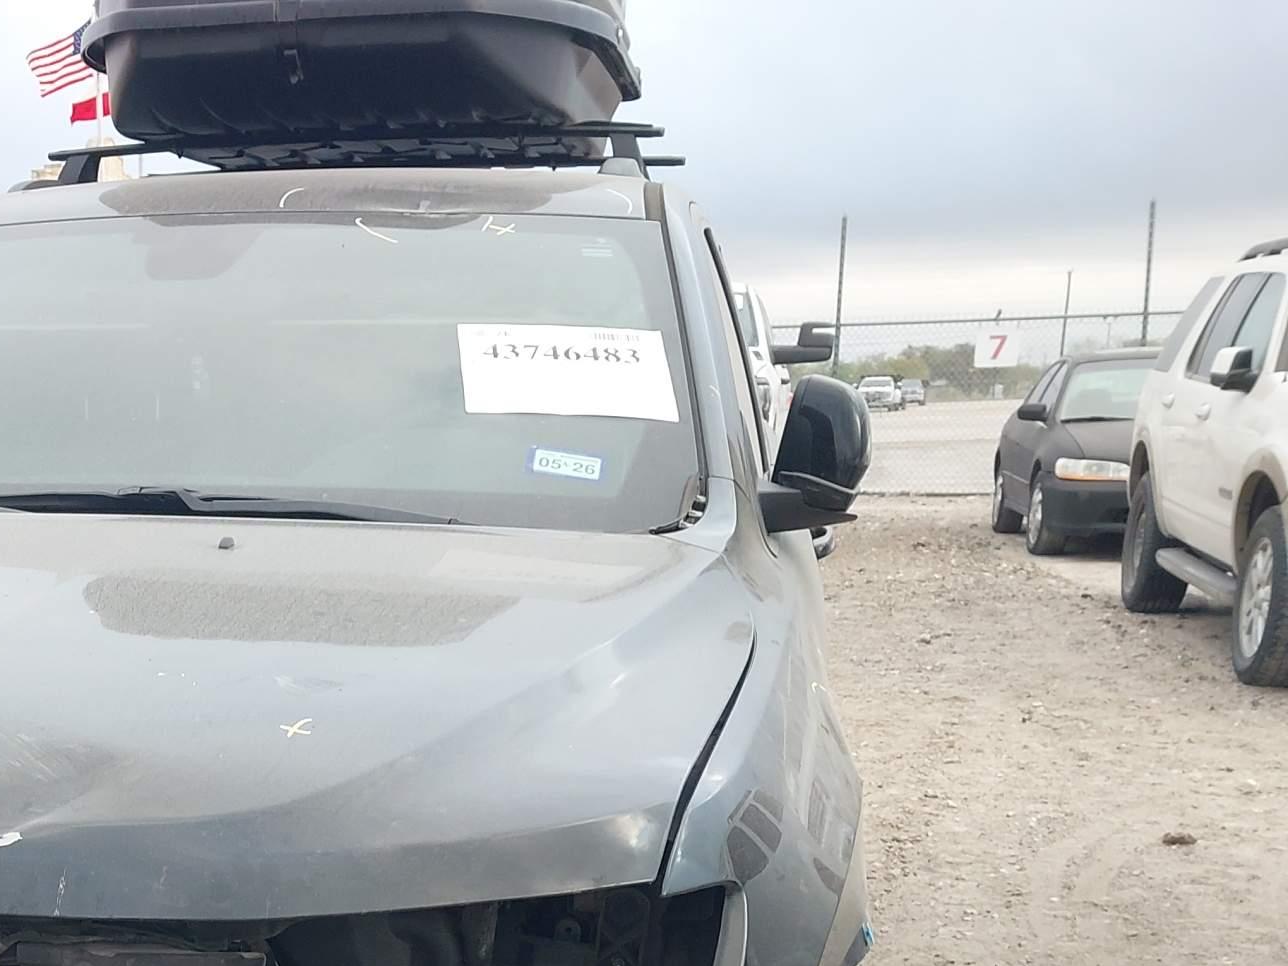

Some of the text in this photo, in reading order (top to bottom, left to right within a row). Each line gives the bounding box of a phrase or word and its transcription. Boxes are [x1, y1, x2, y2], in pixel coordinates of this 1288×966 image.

[482, 343, 641, 364] 43746483
[989, 334, 1009, 361] 7
[538, 456, 596, 475] 05 26
